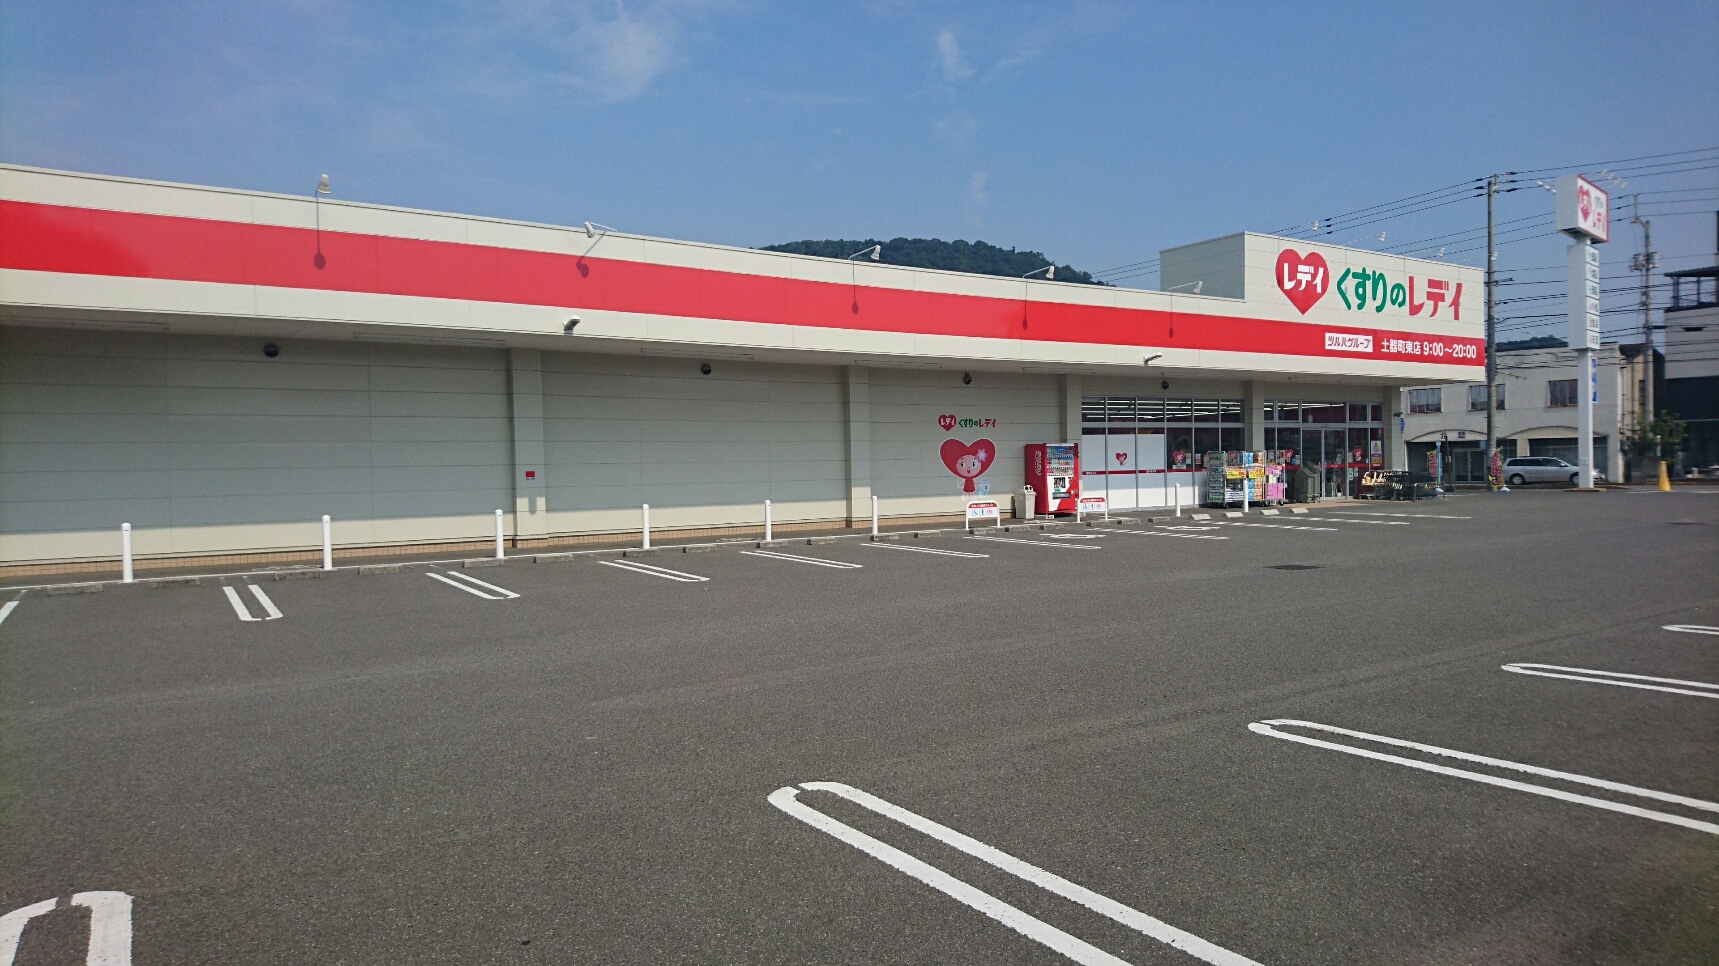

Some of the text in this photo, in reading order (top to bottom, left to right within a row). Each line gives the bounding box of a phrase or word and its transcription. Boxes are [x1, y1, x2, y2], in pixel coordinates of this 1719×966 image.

[1327, 335, 1372, 350] ツルハグループ
[1381, 338, 1422, 355] 土器町東店
